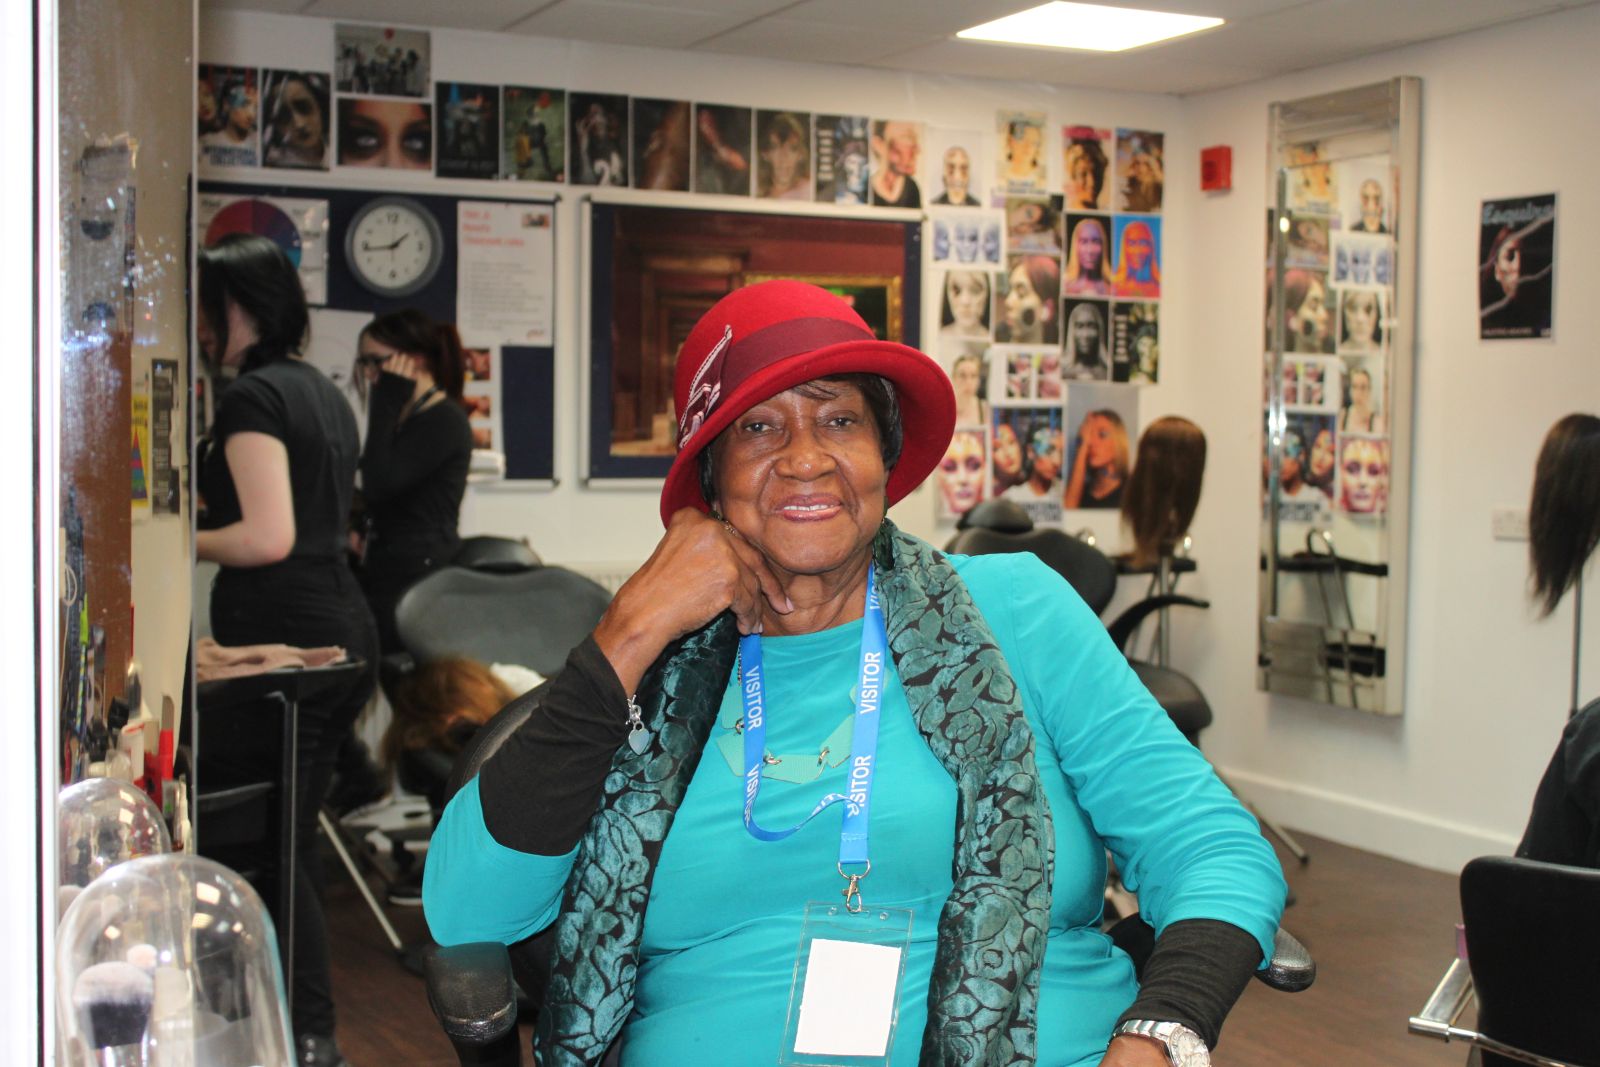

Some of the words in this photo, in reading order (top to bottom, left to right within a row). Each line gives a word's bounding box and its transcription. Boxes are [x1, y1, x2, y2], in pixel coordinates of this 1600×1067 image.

[386, 212, 399, 223] 12
[744, 665, 764, 731] VISITOR
[860, 651, 881, 715] VISITOR
[849, 755, 872, 808] SITOR
